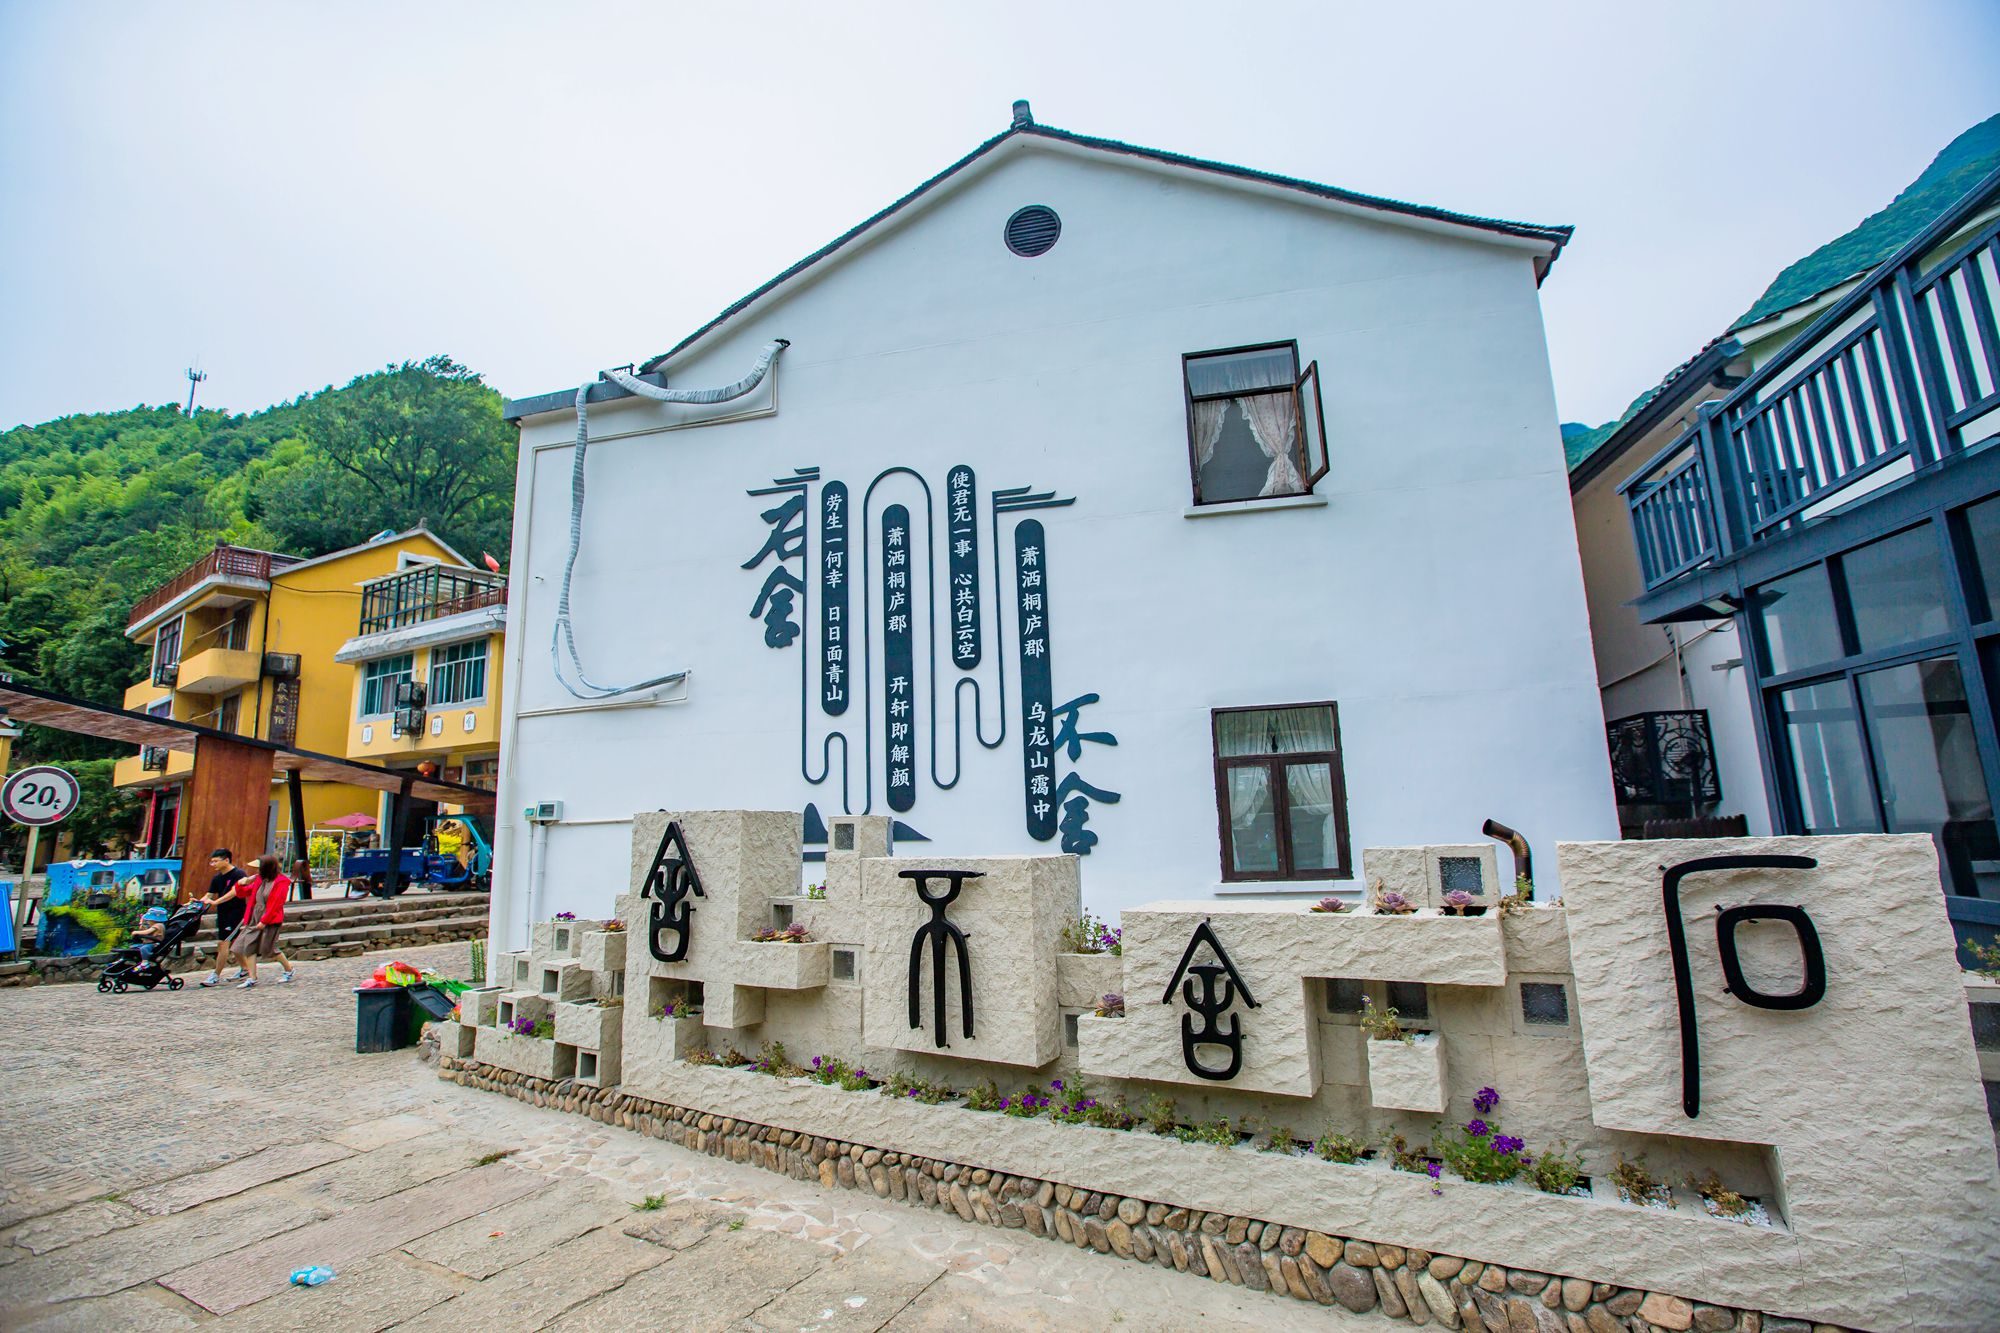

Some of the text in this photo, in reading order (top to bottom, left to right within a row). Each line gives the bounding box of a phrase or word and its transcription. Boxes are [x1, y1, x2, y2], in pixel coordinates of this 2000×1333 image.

[825, 493, 844, 702] 劳生一何幸 日日面青山
[951, 471, 976, 660] 使君无一事 心共白云空
[889, 676, 910, 788] 开轩即解颜
[1028, 701, 1051, 821] 乌龙山霭中
